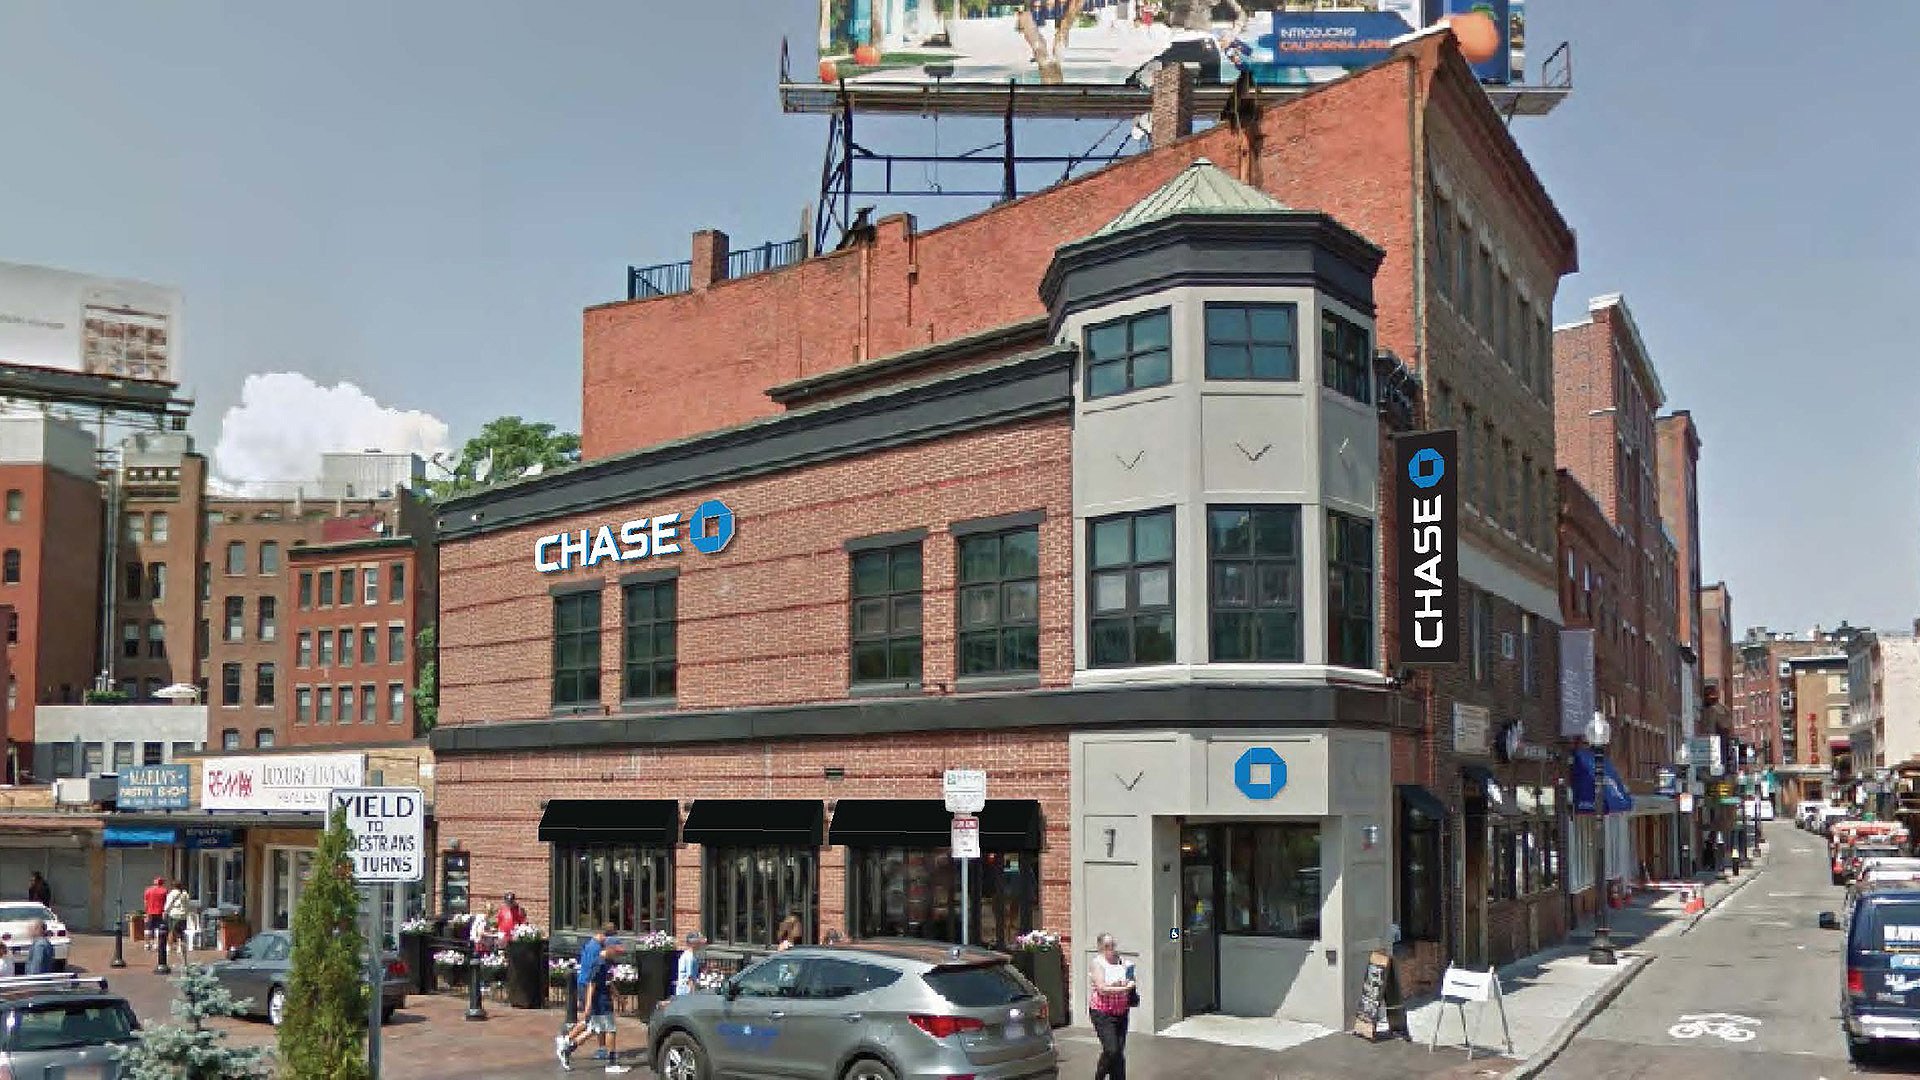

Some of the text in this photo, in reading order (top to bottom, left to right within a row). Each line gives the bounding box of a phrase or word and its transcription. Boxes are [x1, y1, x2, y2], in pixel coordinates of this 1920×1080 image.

[535, 513, 682, 572] CHASE
[1413, 494, 1443, 648] CHASE
[337, 796, 414, 818] YIELD
[366, 820, 384, 832] TO
